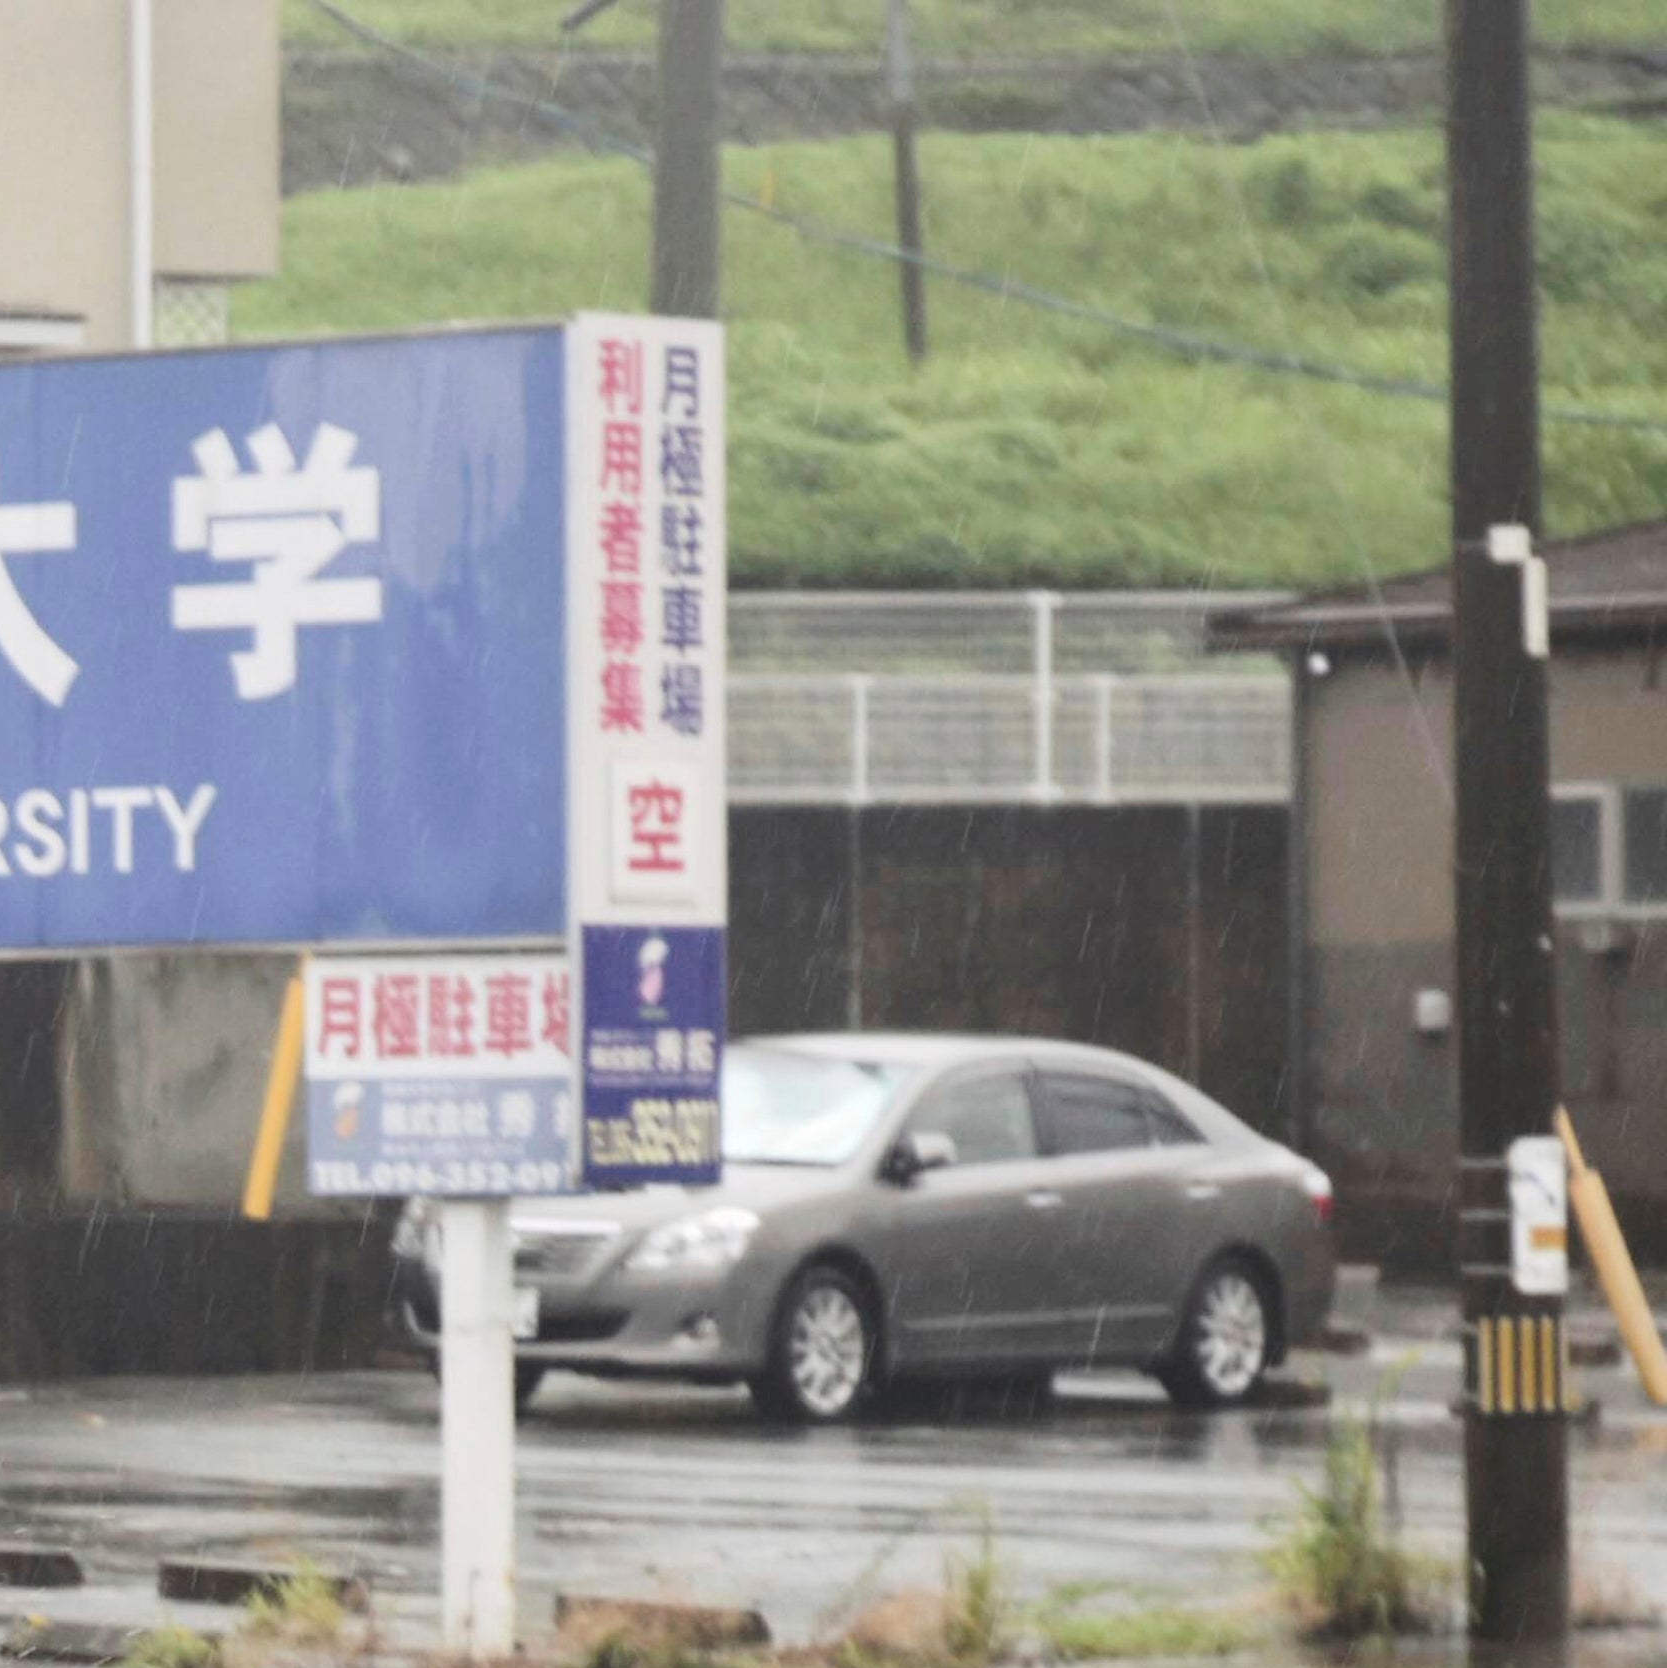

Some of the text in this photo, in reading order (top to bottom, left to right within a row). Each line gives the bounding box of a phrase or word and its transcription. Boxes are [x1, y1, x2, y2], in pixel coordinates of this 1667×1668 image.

[597, 336, 645, 734] 利用者募集
[658, 344, 704, 736] 月極駐車場
[625, 776, 685, 873] 空
